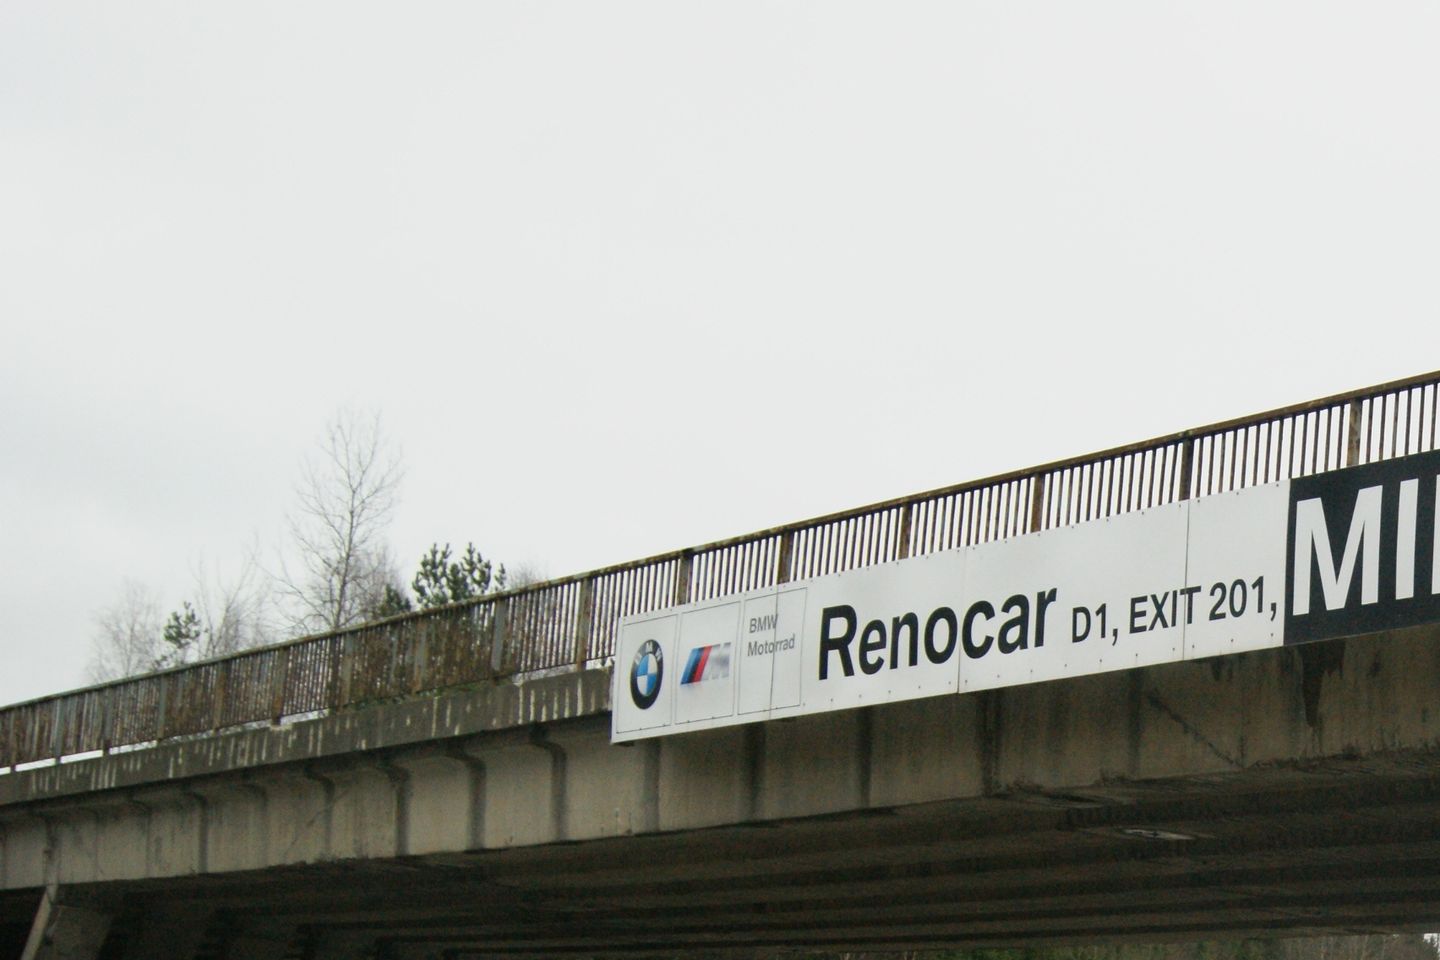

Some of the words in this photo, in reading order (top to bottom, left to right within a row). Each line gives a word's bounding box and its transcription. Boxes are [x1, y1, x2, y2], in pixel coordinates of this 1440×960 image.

[749, 613, 779, 634] BMW
[817, 587, 1058, 681] Renocar
[1071, 604, 1119, 647] D1,
[1128, 585, 1202, 635] EXIT
[1208, 575, 1278, 622] 201,
[747, 633, 796, 657] Motorrad
